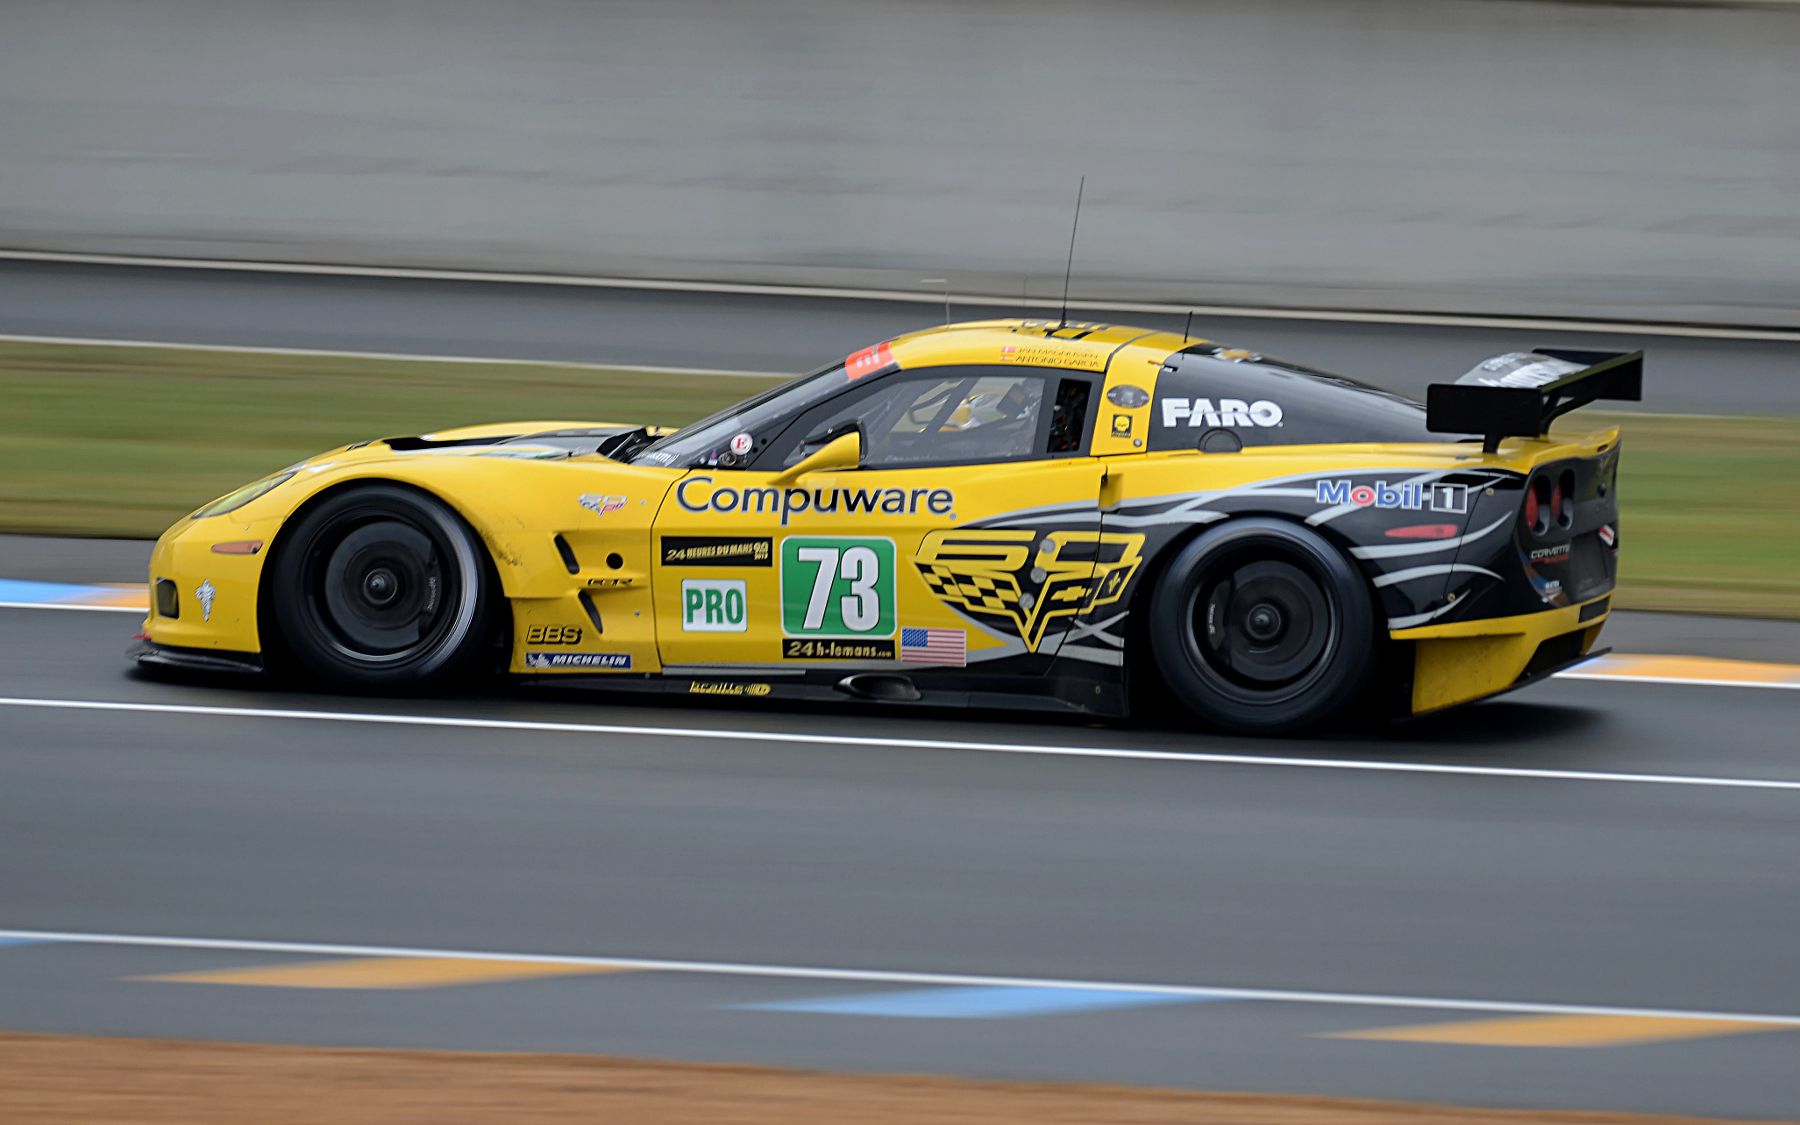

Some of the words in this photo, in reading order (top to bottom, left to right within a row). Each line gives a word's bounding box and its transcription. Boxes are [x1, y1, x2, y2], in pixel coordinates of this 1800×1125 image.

[1161, 398, 1283, 428] FARO
[676, 476, 953, 526] Compuware
[1316, 480, 1423, 510] Mobil
[665, 549, 686, 560] 24
[717, 545, 730, 555] DU
[798, 546, 881, 631] 73
[685, 588, 744, 624] PRO
[526, 624, 583, 645] BBS
[552, 655, 627, 666] MICHELIN
